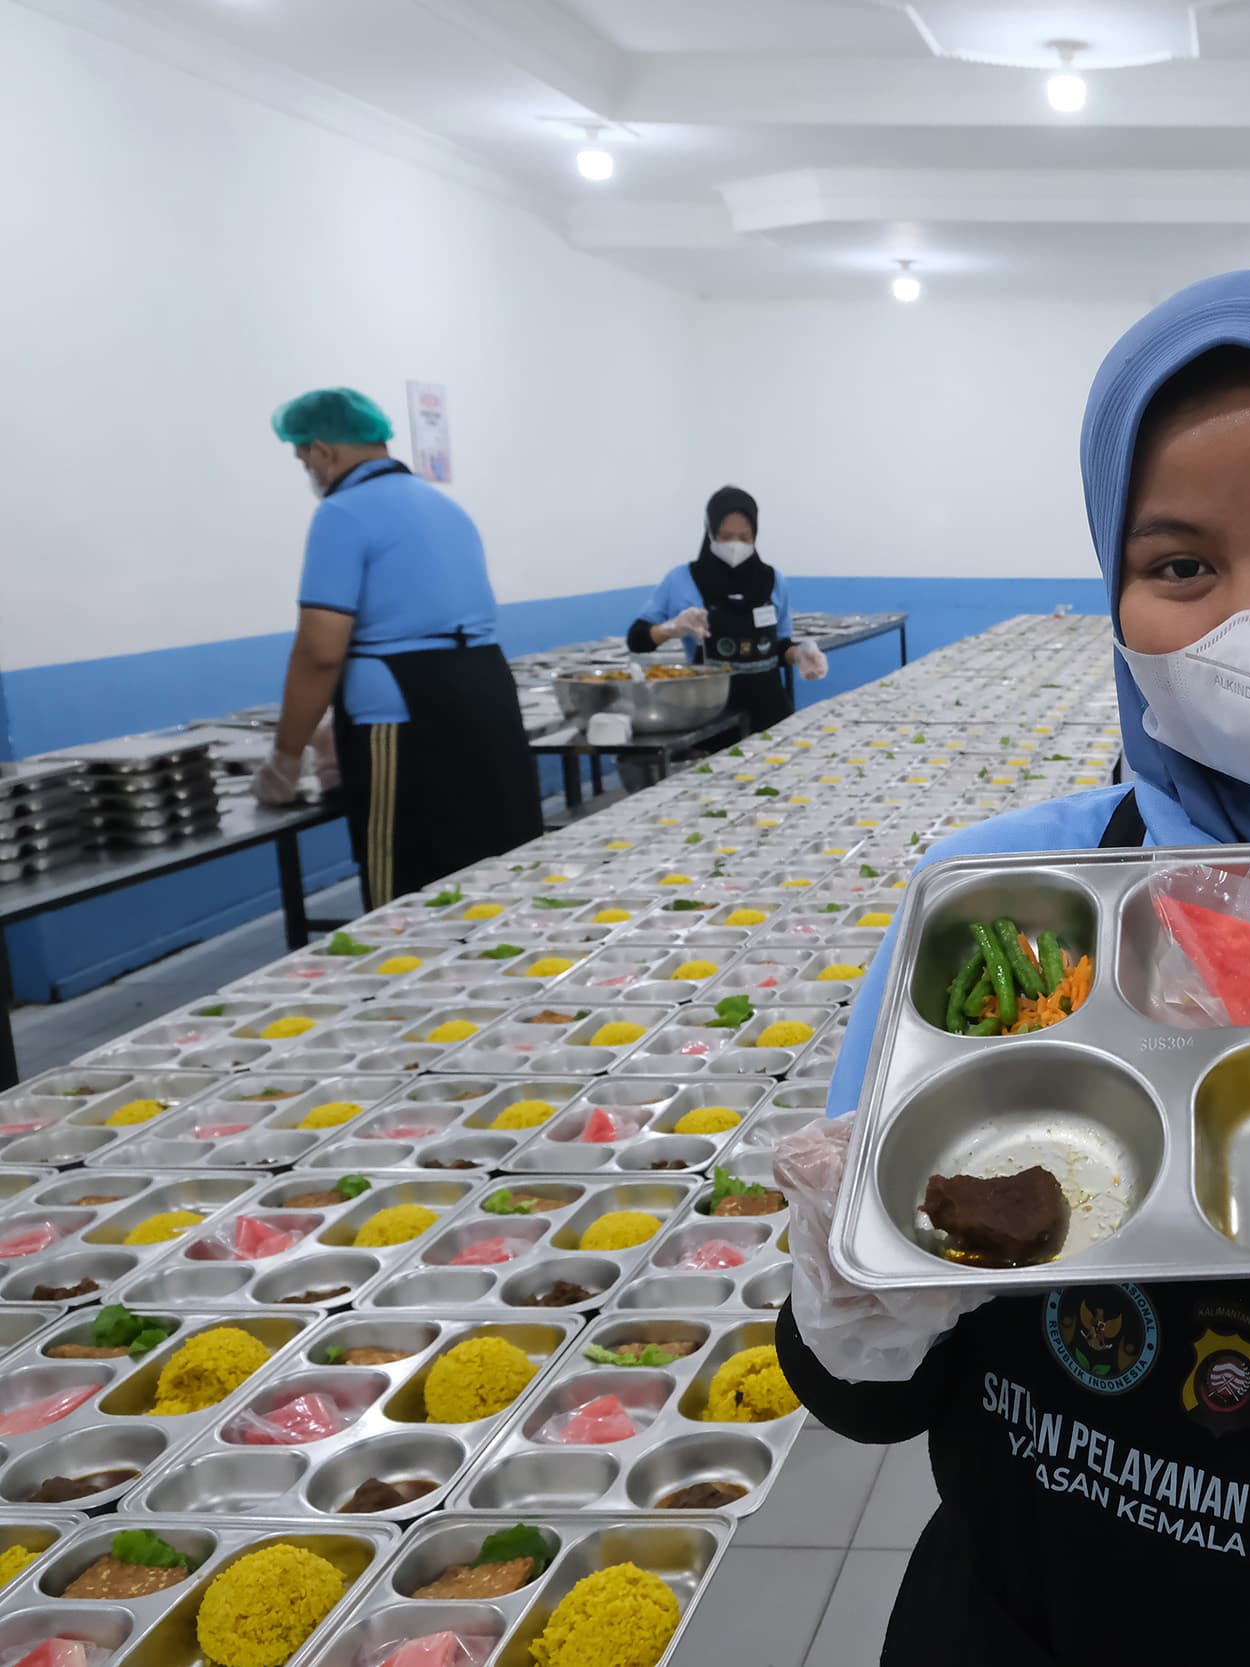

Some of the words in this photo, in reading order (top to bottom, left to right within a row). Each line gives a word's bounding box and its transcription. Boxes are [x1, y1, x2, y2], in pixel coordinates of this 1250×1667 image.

[1140, 1035, 1194, 1051] SUS304
[1048, 1320, 1086, 1380] REPUBLIK
[1087, 1359, 1148, 1391] INDONESIA
[1067, 1420, 1249, 1524] PELAYANAN
[1116, 1495, 1246, 1557] KEMALA
